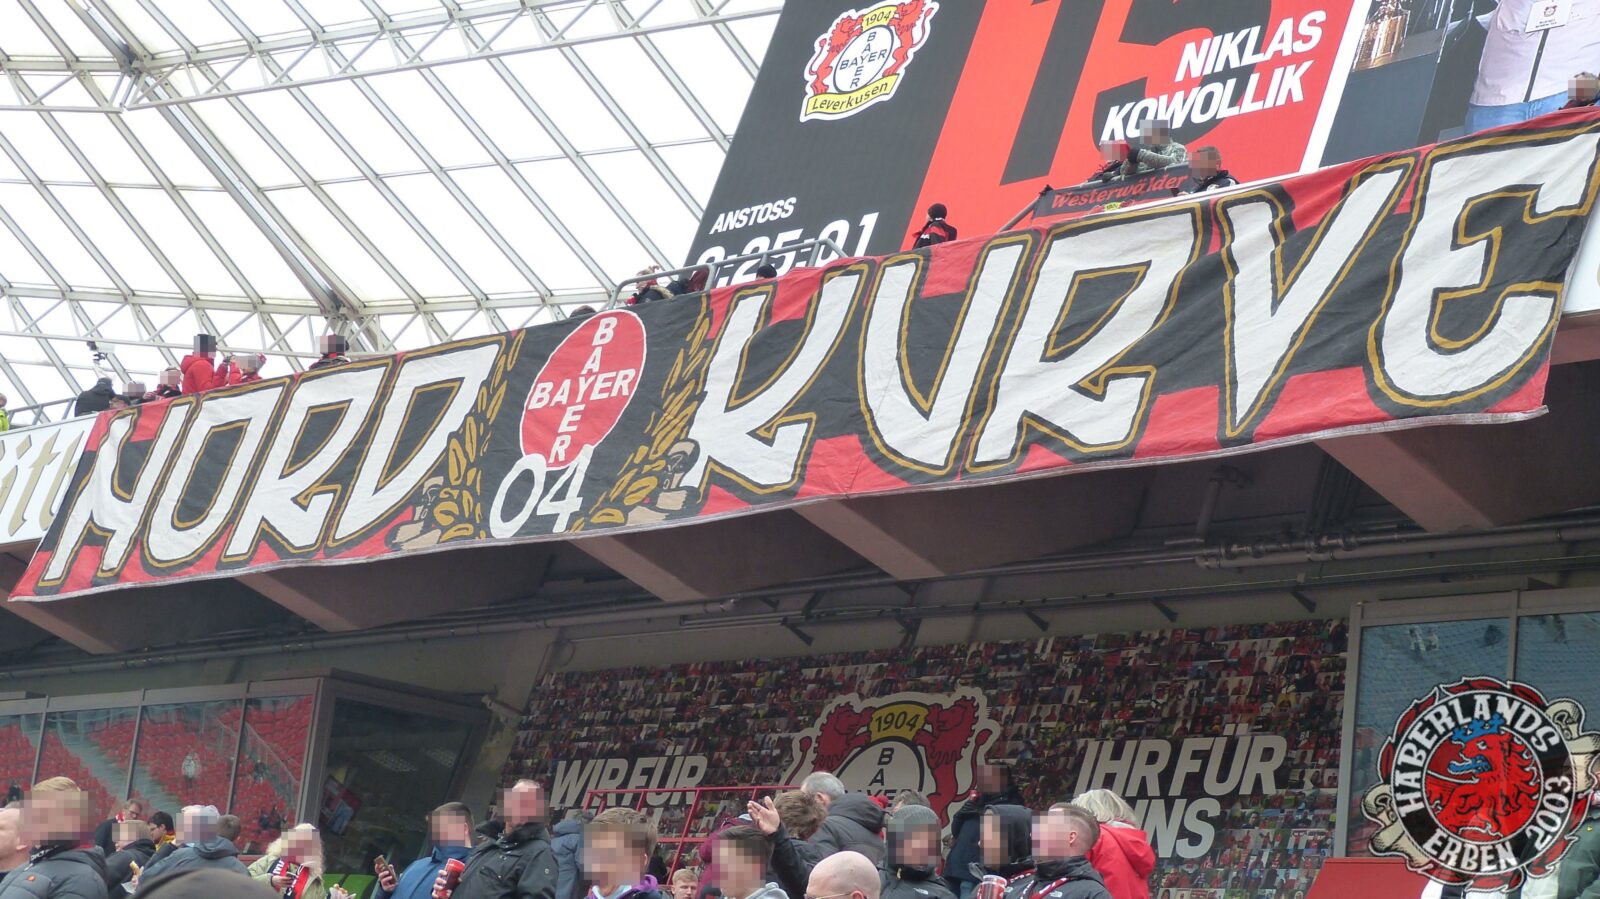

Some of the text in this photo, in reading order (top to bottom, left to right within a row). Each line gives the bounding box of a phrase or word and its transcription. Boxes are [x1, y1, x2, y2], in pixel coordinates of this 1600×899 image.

[865, 10, 891, 26] 1904
[1174, 10, 1326, 82] NIKLAS
[840, 49, 887, 70] BAYER
[850, 31, 877, 88] BAYER
[812, 82, 888, 110] Leverkusen
[1100, 60, 1314, 142] KOWOLLIK
[709, 197, 797, 234] ANSTOSS
[1052, 174, 1188, 208] Westerwälder
[38, 130, 1600, 588] NORD KURVE
[528, 368, 636, 410] BAYER
[548, 316, 617, 463] BAYER
[489, 445, 594, 539] 04
[875, 711, 920, 733] 1904
[550, 745, 708, 811] WIR FÜR
[1074, 723, 1288, 797] IHR FÜR
